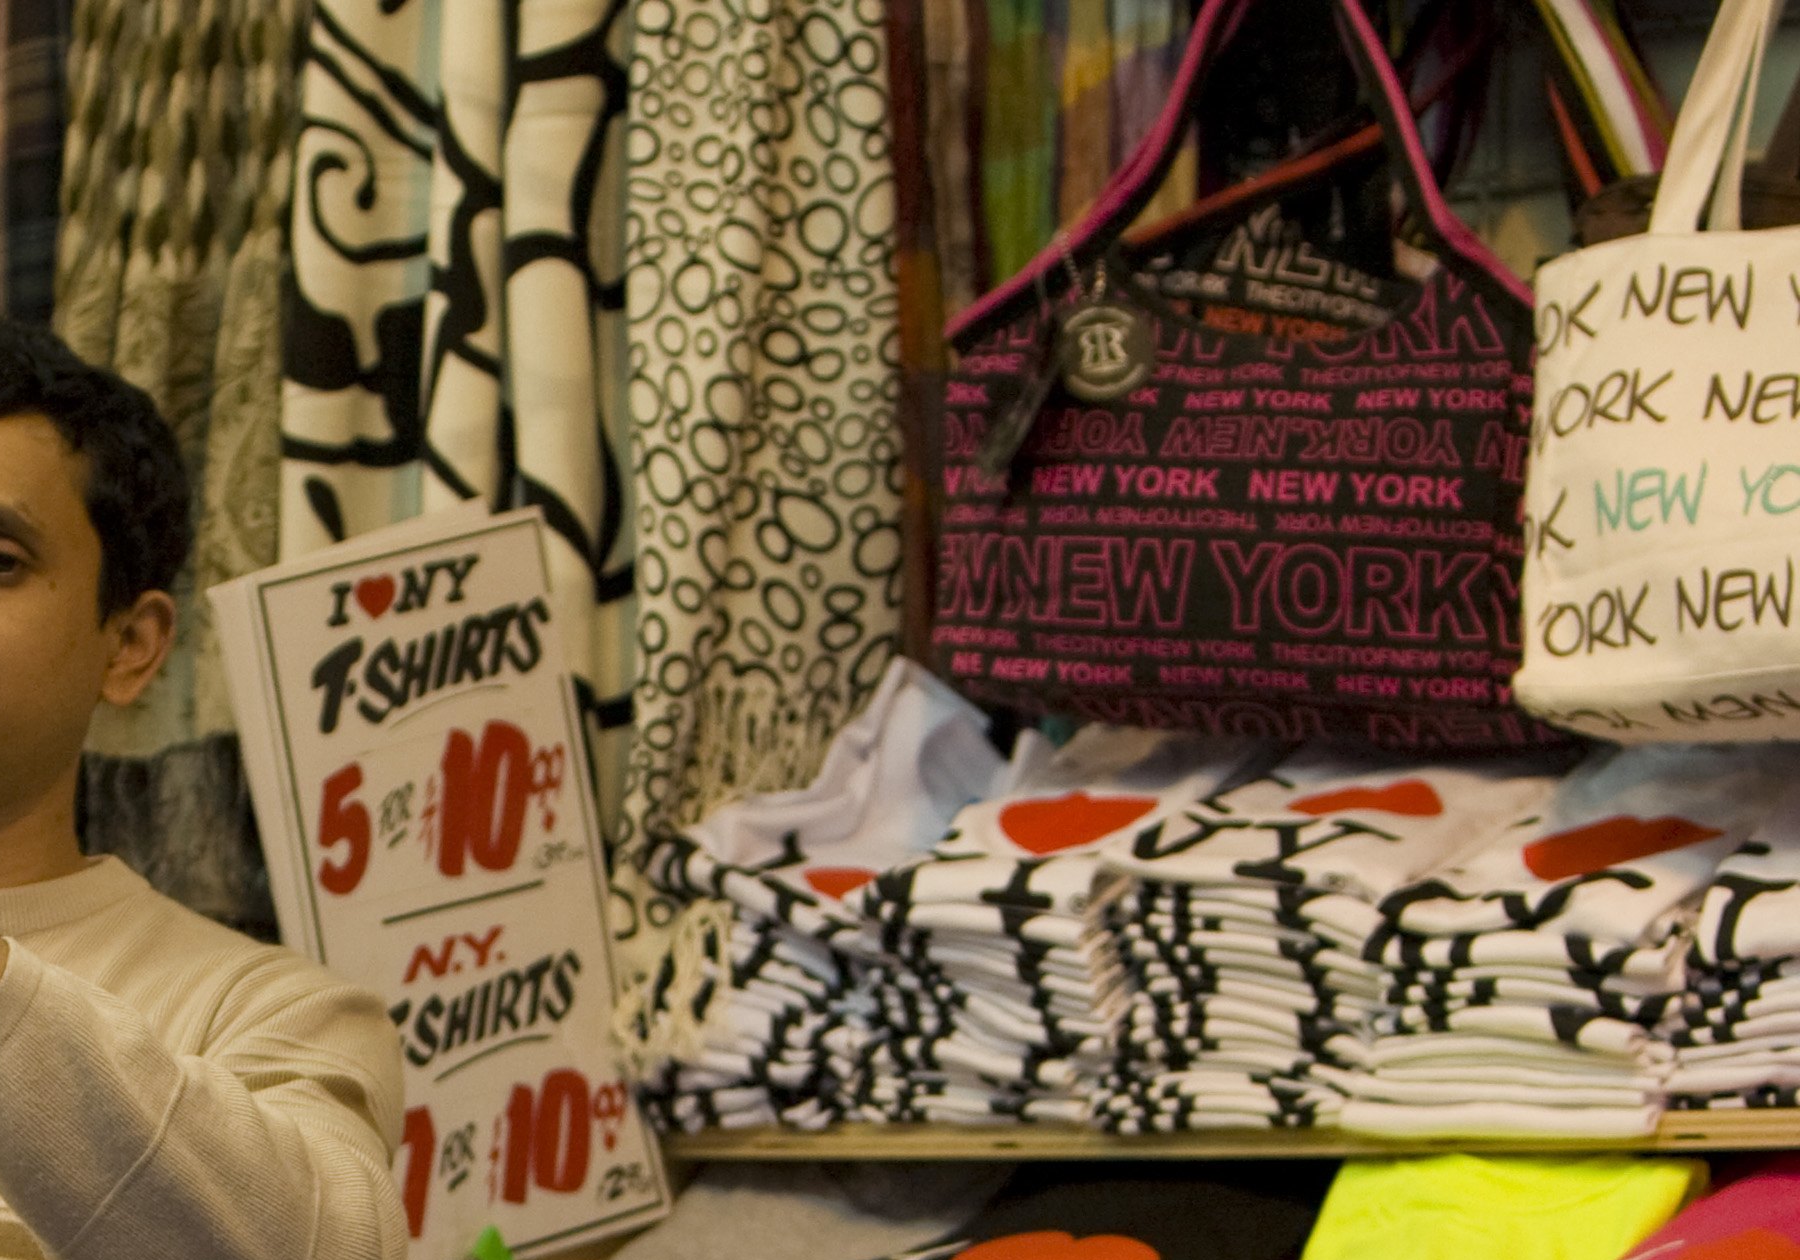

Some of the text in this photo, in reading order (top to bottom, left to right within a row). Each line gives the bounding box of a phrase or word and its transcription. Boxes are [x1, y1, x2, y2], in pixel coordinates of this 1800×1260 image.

[1620, 261, 1753, 331] NEW
[1183, 390, 1248, 412] NEW
[1253, 387, 1334, 414] YORK
[1355, 385, 1423, 411] NEW
[1428, 386, 1507, 411] YORK
[1032, 463, 1106, 497] NEW
[1114, 464, 1220, 499] YORK
[1248, 469, 1341, 503] NEW
[1349, 472, 1465, 510] YORK
[1593, 457, 1709, 537] NEW
[327, 552, 481, 628] I NY
[1000, 534, 1197, 629] NEW
[1208, 539, 1492, 641] YORK
[1675, 554, 1796, 635] NEW
[989, 655, 1053, 682] NEW
[1055, 661, 1134, 686] YORK
[1157, 664, 1226, 686] NEW
[1228, 667, 1311, 691] YORK
[1333, 672, 1402, 695] NEW
[1406, 675, 1493, 699] YORK
[317, 760, 372, 896] 5
[403, 924, 507, 985] N.Y.
